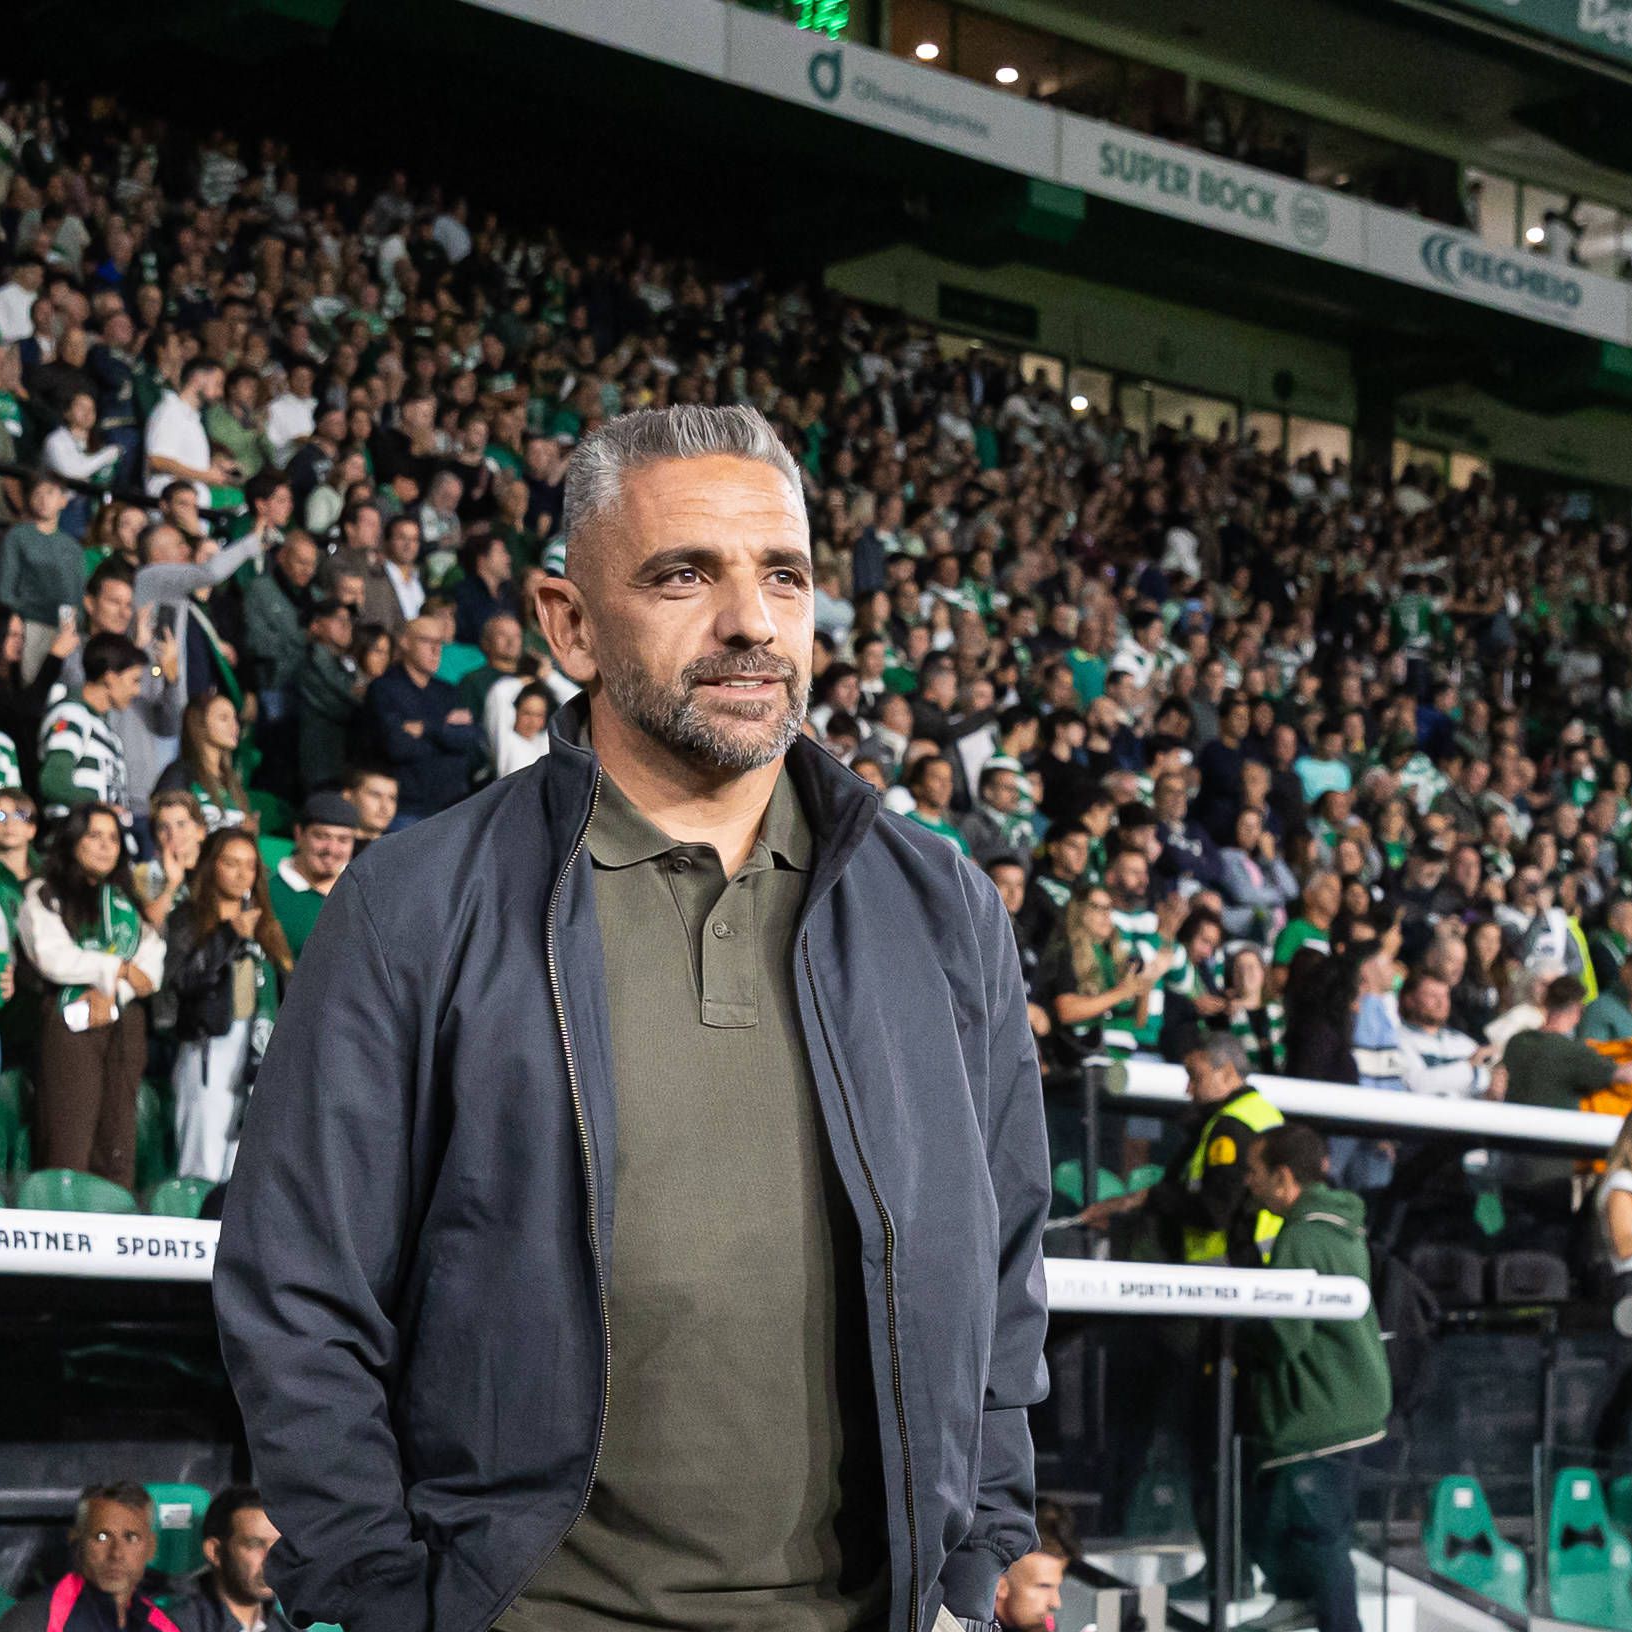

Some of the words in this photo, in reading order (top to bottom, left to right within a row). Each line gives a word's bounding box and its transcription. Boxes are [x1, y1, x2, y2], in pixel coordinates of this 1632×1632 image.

[1099, 140, 1192, 200] SUPER
[1197, 168, 1278, 225] BOCK
[116, 1236, 207, 1259] SPORTS
